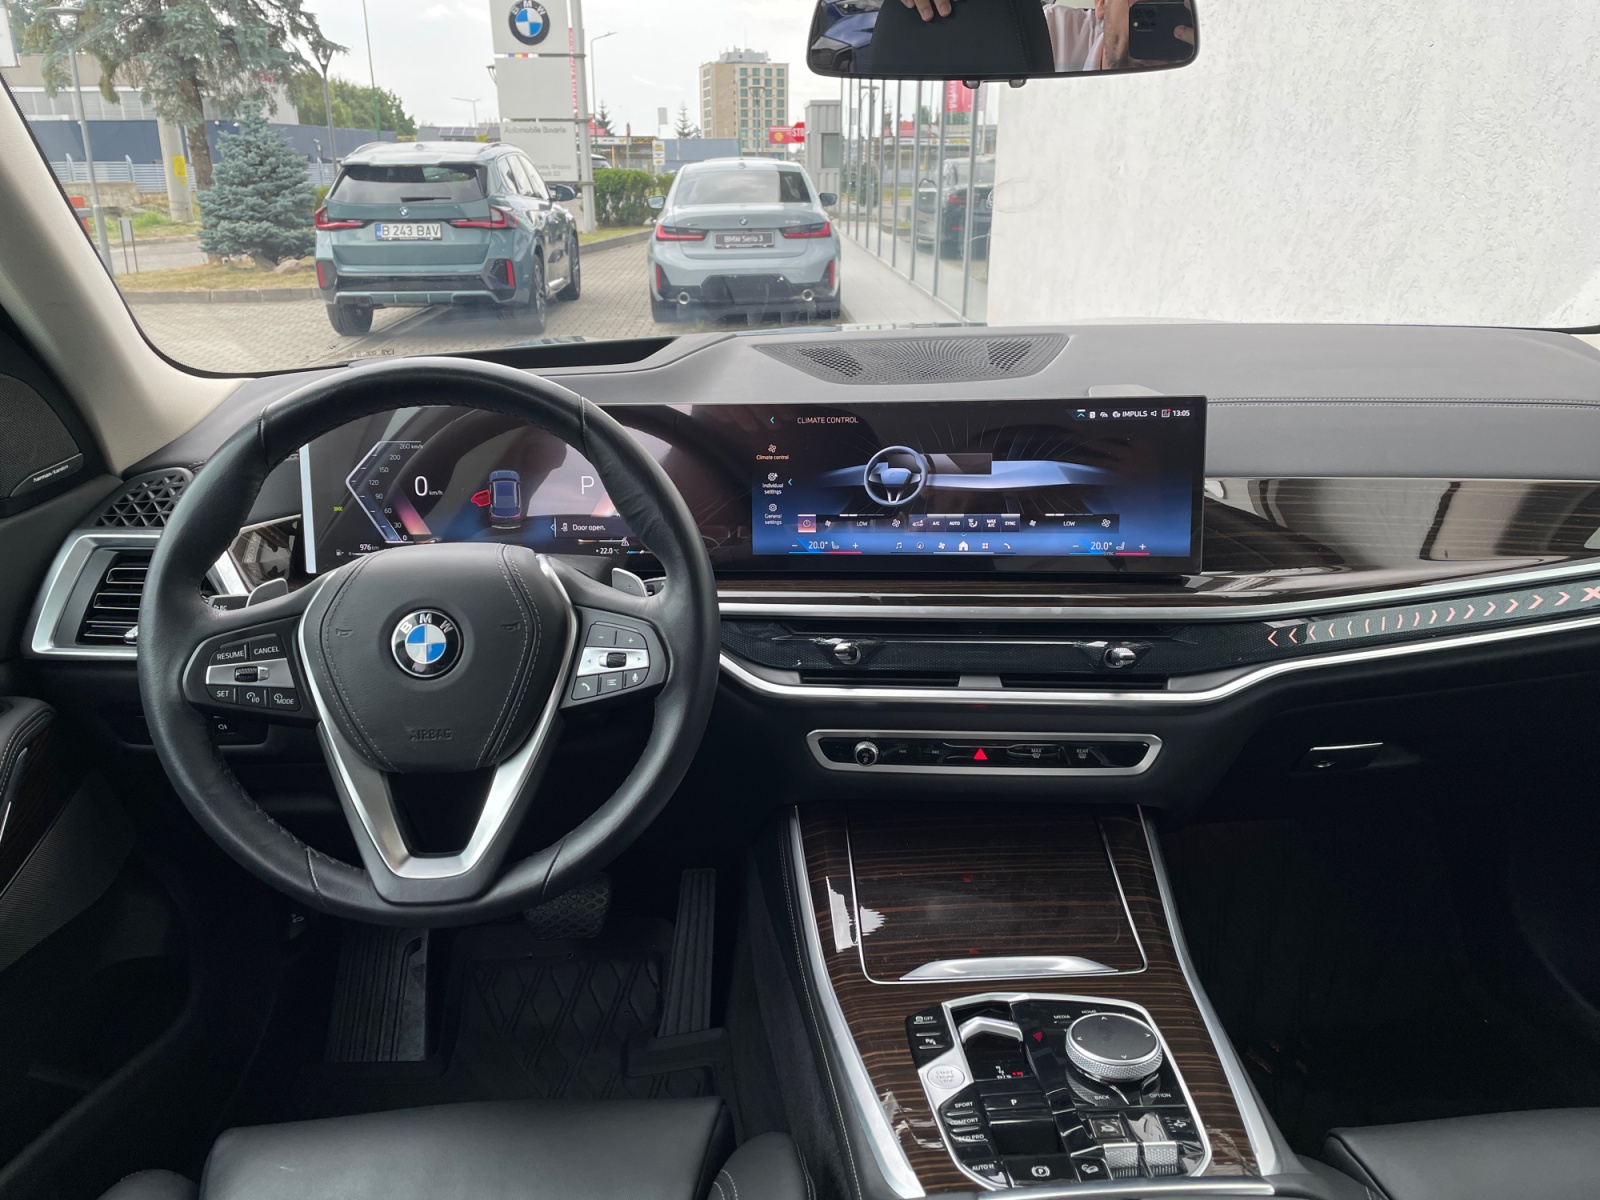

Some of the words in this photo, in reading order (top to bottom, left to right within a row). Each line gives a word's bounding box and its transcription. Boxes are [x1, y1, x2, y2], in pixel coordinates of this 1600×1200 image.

[511, 0, 546, 15] BMW
[382, 224, 390, 236] B
[393, 224, 412, 236] 243
[417, 224, 440, 236] BAV
[1172, 409, 1190, 417] 13:05
[826, 416, 859, 424] CONTROL
[414, 475, 428, 496] 0
[581, 476, 595, 496] P
[400, 613, 454, 634] BMW
[216, 650, 244, 660] RESUME
[253, 646, 279, 655] CANCEL
[216, 690, 229, 698] SET
[409, 728, 452, 741] AIRBAG
[954, 1101, 973, 1109] SPORT
[950, 1117, 978, 1126] COMFORT
[972, 1163, 988, 1171] AUTO
